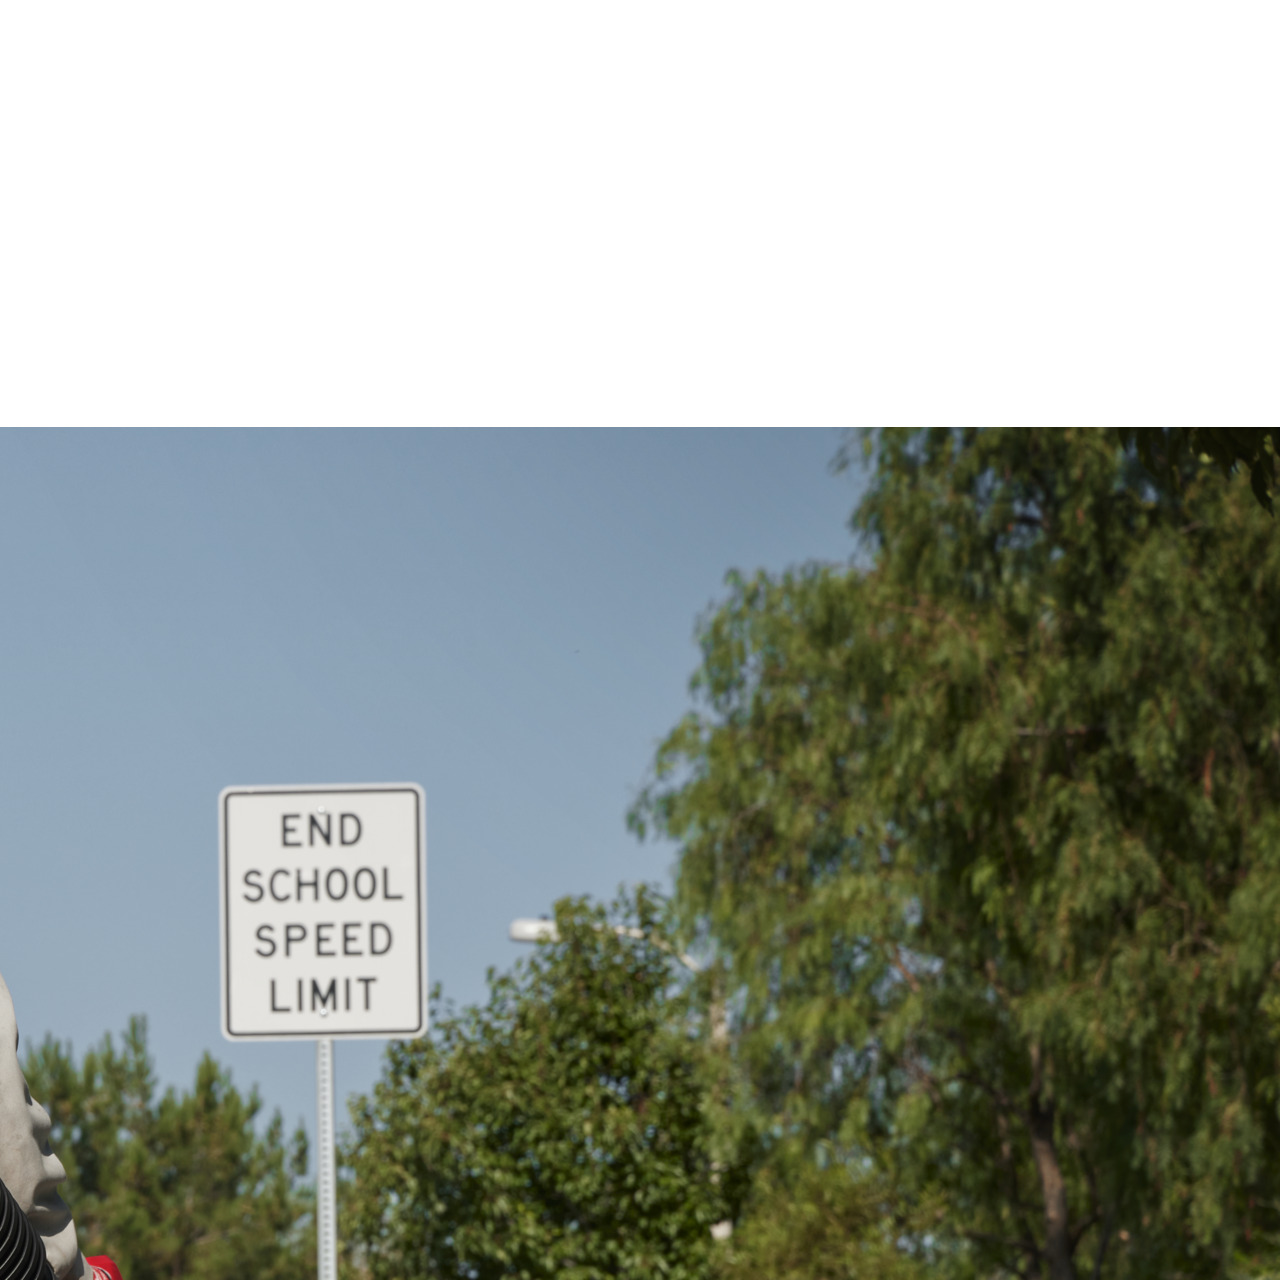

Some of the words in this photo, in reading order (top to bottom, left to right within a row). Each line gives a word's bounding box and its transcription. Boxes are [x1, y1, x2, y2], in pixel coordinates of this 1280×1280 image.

[281, 813, 362, 847] END
[242, 867, 404, 903] SCHOOL
[255, 922, 393, 958] SPEED
[270, 977, 378, 1013] LIMIT
